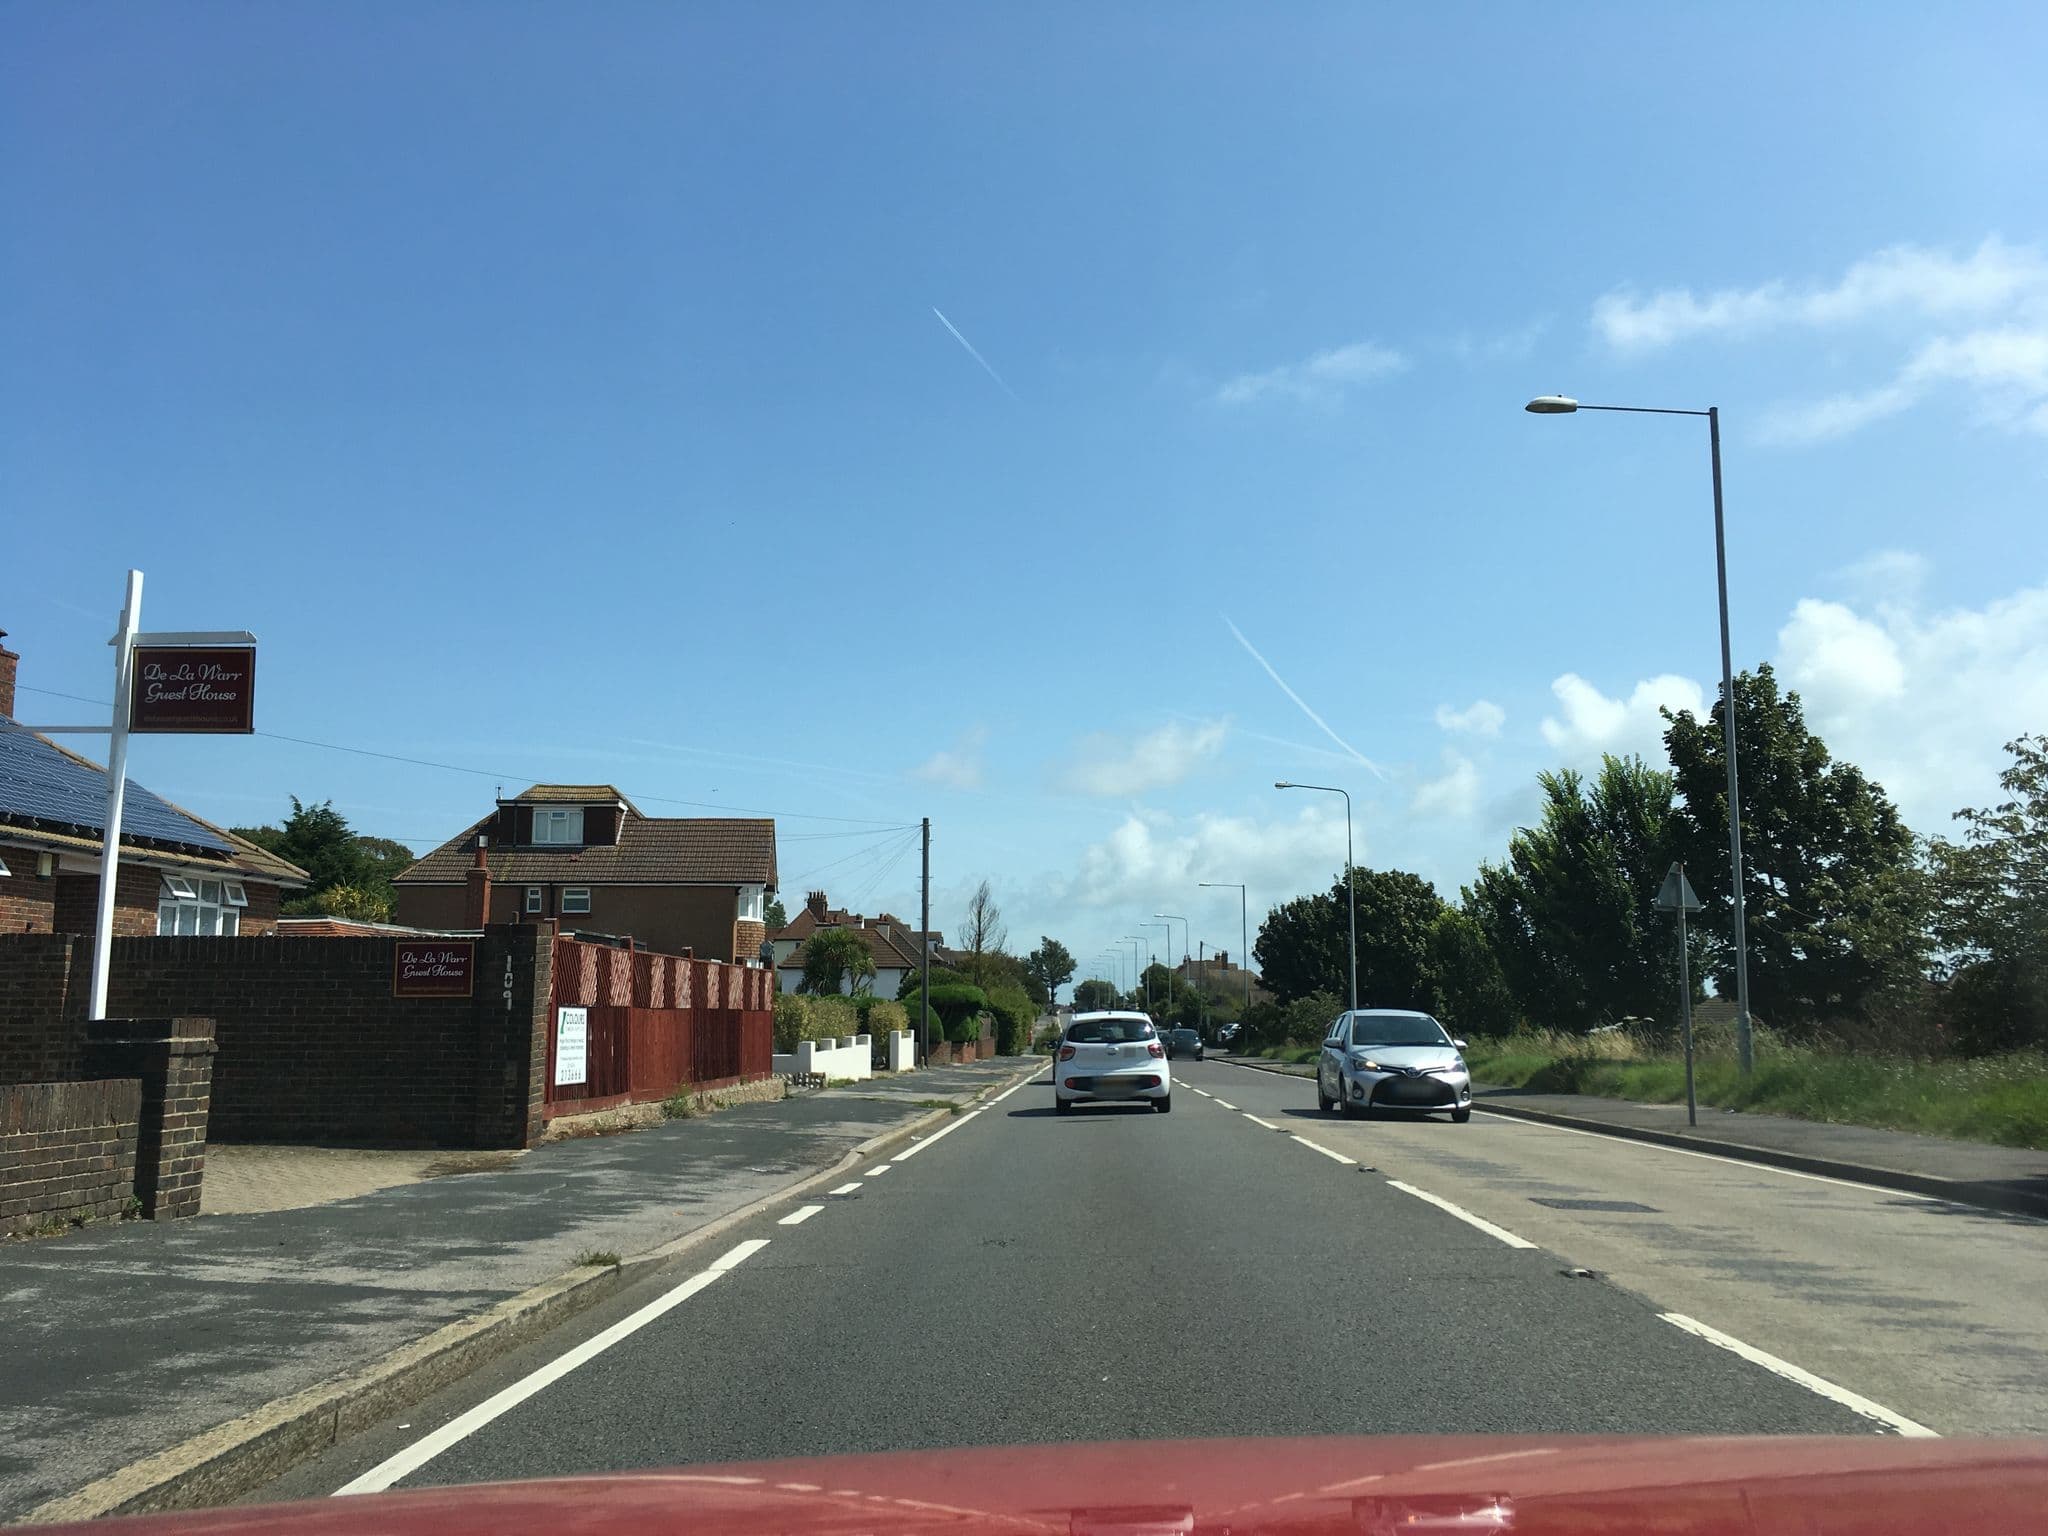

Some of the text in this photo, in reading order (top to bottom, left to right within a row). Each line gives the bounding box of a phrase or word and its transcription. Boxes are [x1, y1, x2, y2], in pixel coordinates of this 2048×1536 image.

[144, 664, 242, 681] De La Warr
[145, 683, 237, 703] Guest House
[401, 952, 468, 963] De La Warr
[403, 965, 464, 979] Guest House
[503, 955, 513, 1011] 109
